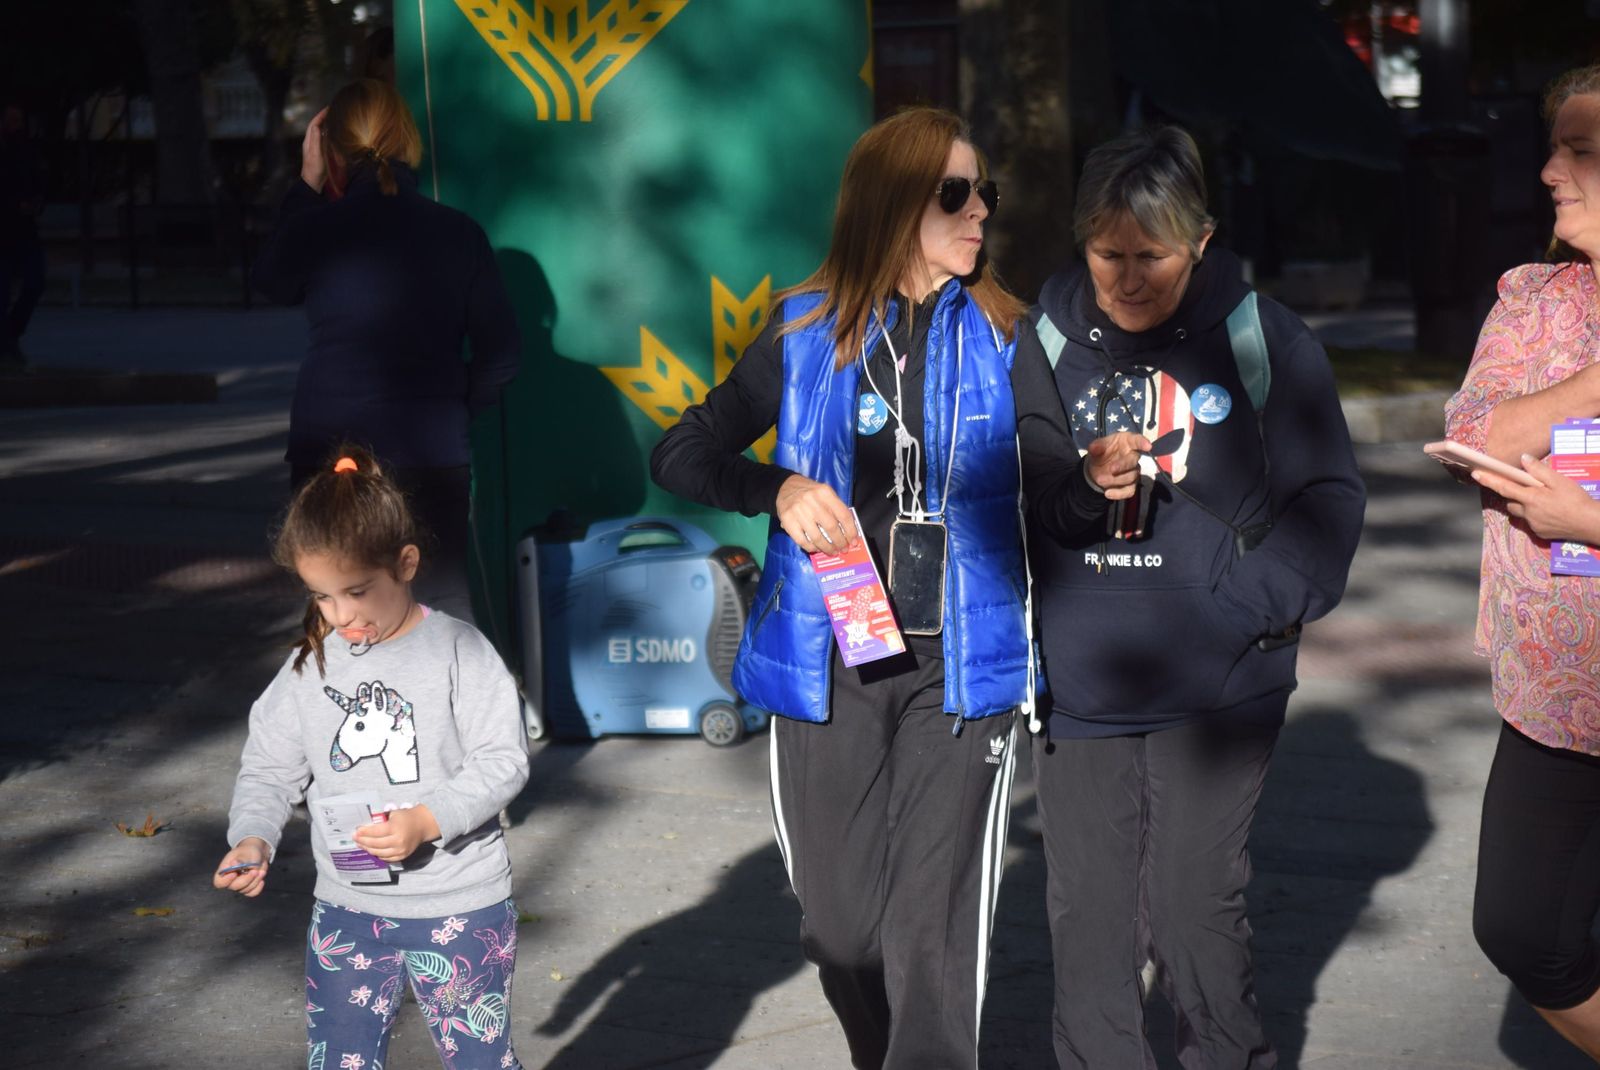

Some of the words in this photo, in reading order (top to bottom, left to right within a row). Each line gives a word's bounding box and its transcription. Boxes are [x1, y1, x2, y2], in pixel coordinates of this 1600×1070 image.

[1133, 555, 1143, 567] &
[1144, 554, 1163, 568] CO
[635, 639, 697, 663] SDMO
